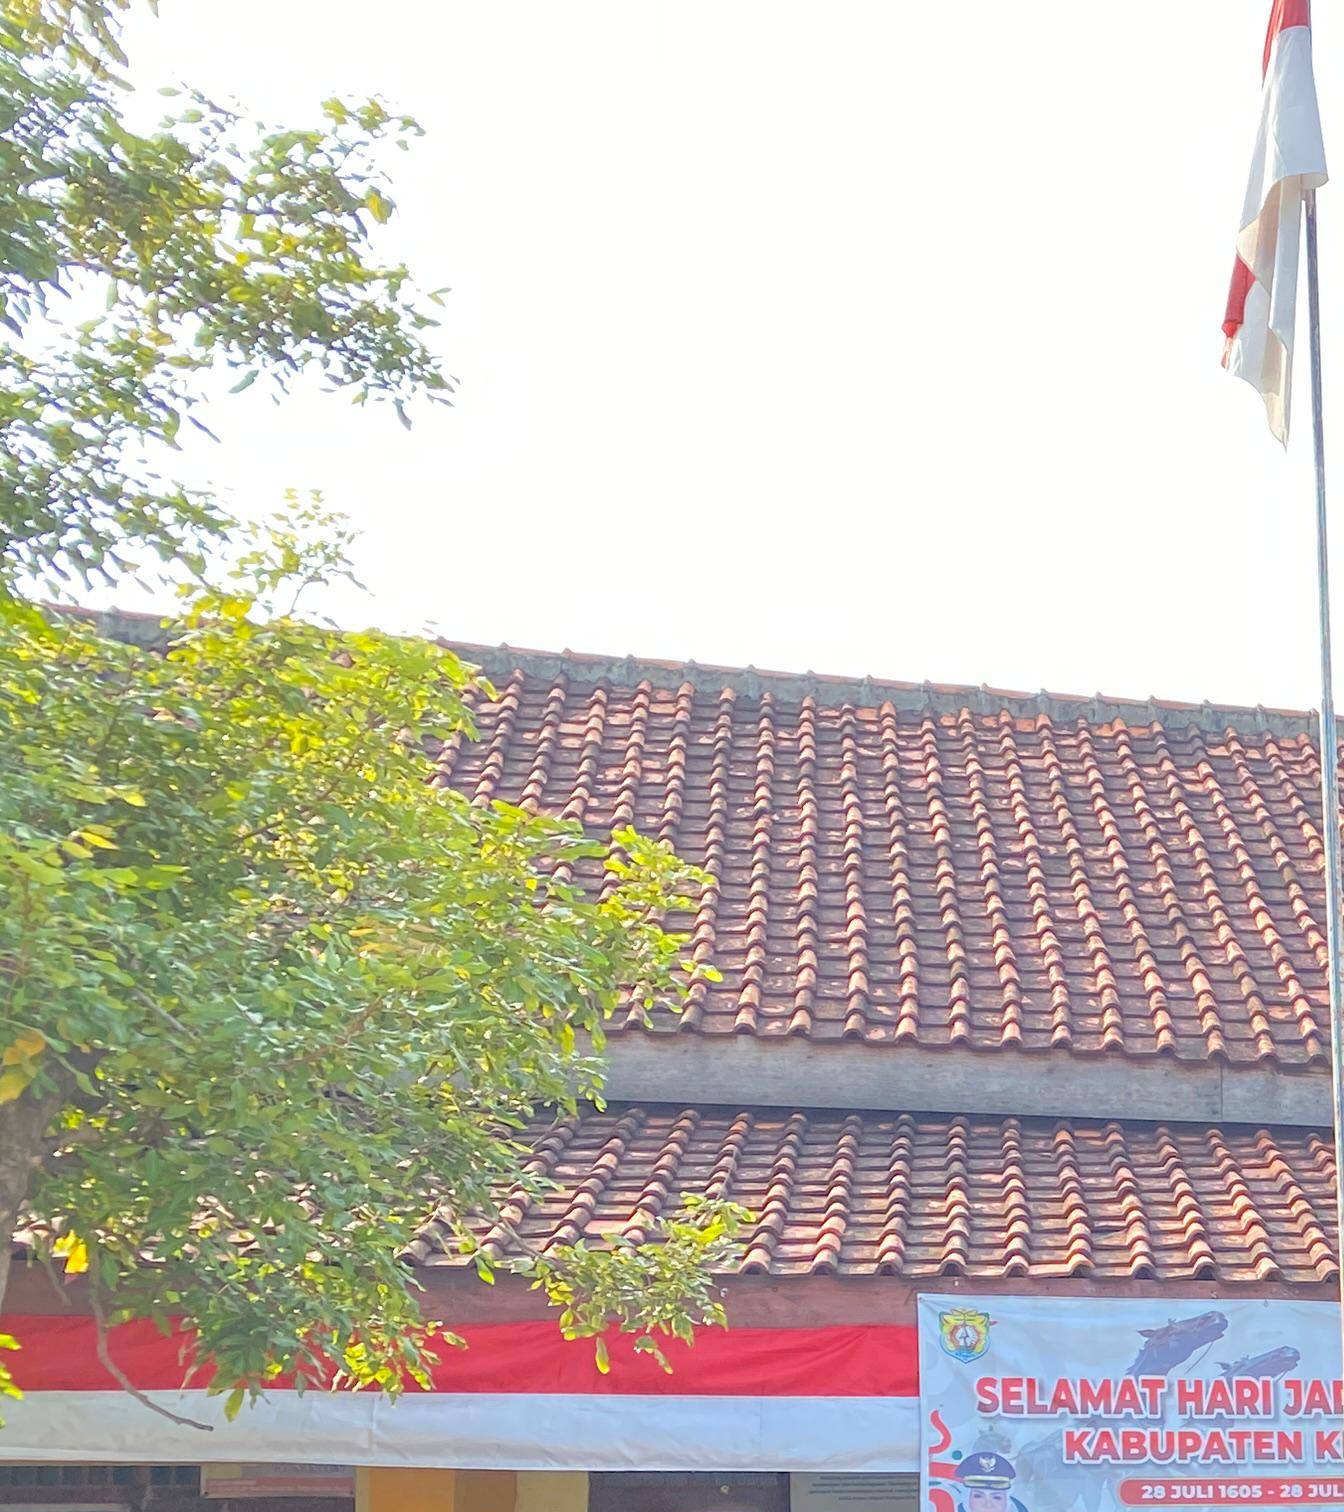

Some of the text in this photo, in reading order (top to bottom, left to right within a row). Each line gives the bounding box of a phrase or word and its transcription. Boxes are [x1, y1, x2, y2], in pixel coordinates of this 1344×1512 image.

[976, 1377, 1165, 1415] SELAMAT
[1177, 1378, 1271, 1415] HARI
[1065, 1430, 1302, 1461] KABUPATEN
[1141, 1485, 1166, 1499] 28
[1170, 1485, 1214, 1499] JULI
[1218, 1484, 1262, 1498] 1605
[1280, 1484, 1303, 1498] 28
